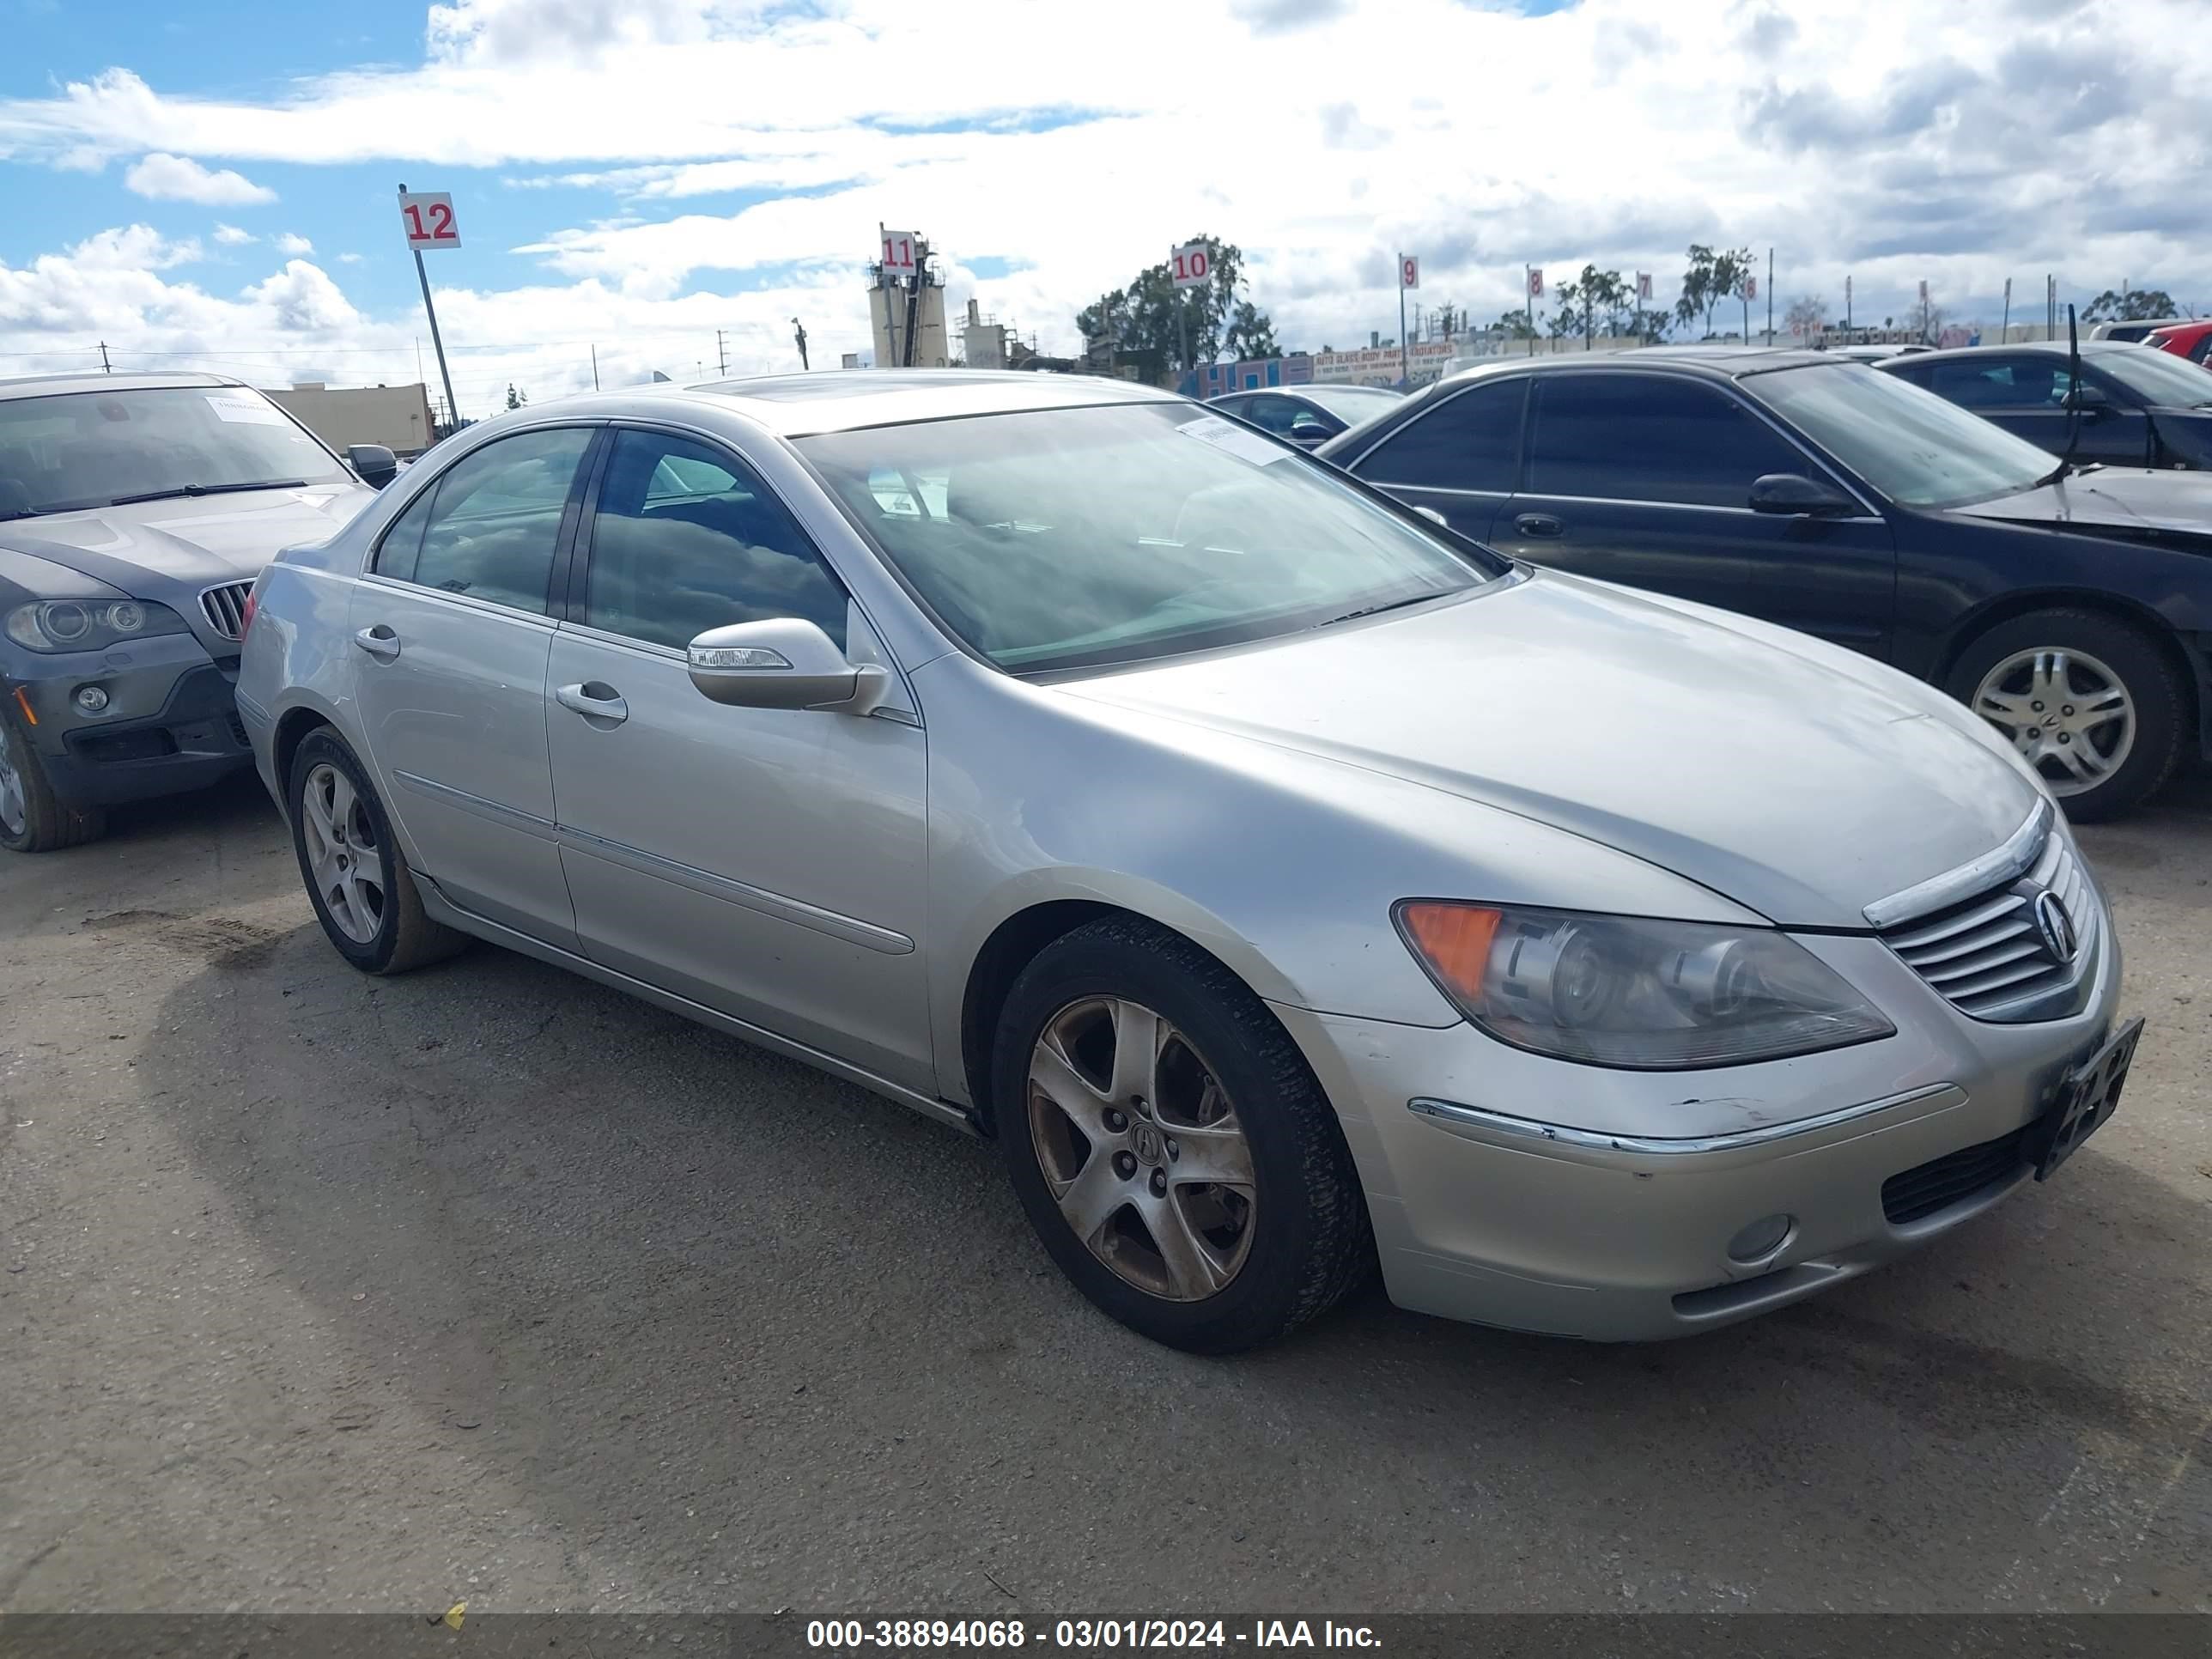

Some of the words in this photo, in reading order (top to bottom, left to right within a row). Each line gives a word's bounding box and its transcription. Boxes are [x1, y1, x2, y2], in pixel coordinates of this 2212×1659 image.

[404, 204, 456, 240] 12
[883, 237, 914, 267] 11
[1173, 252, 1206, 280] 10
[1404, 260, 1415, 285] 9
[1530, 272, 1540, 295] 8
[1640, 276, 1650, 296] 7
